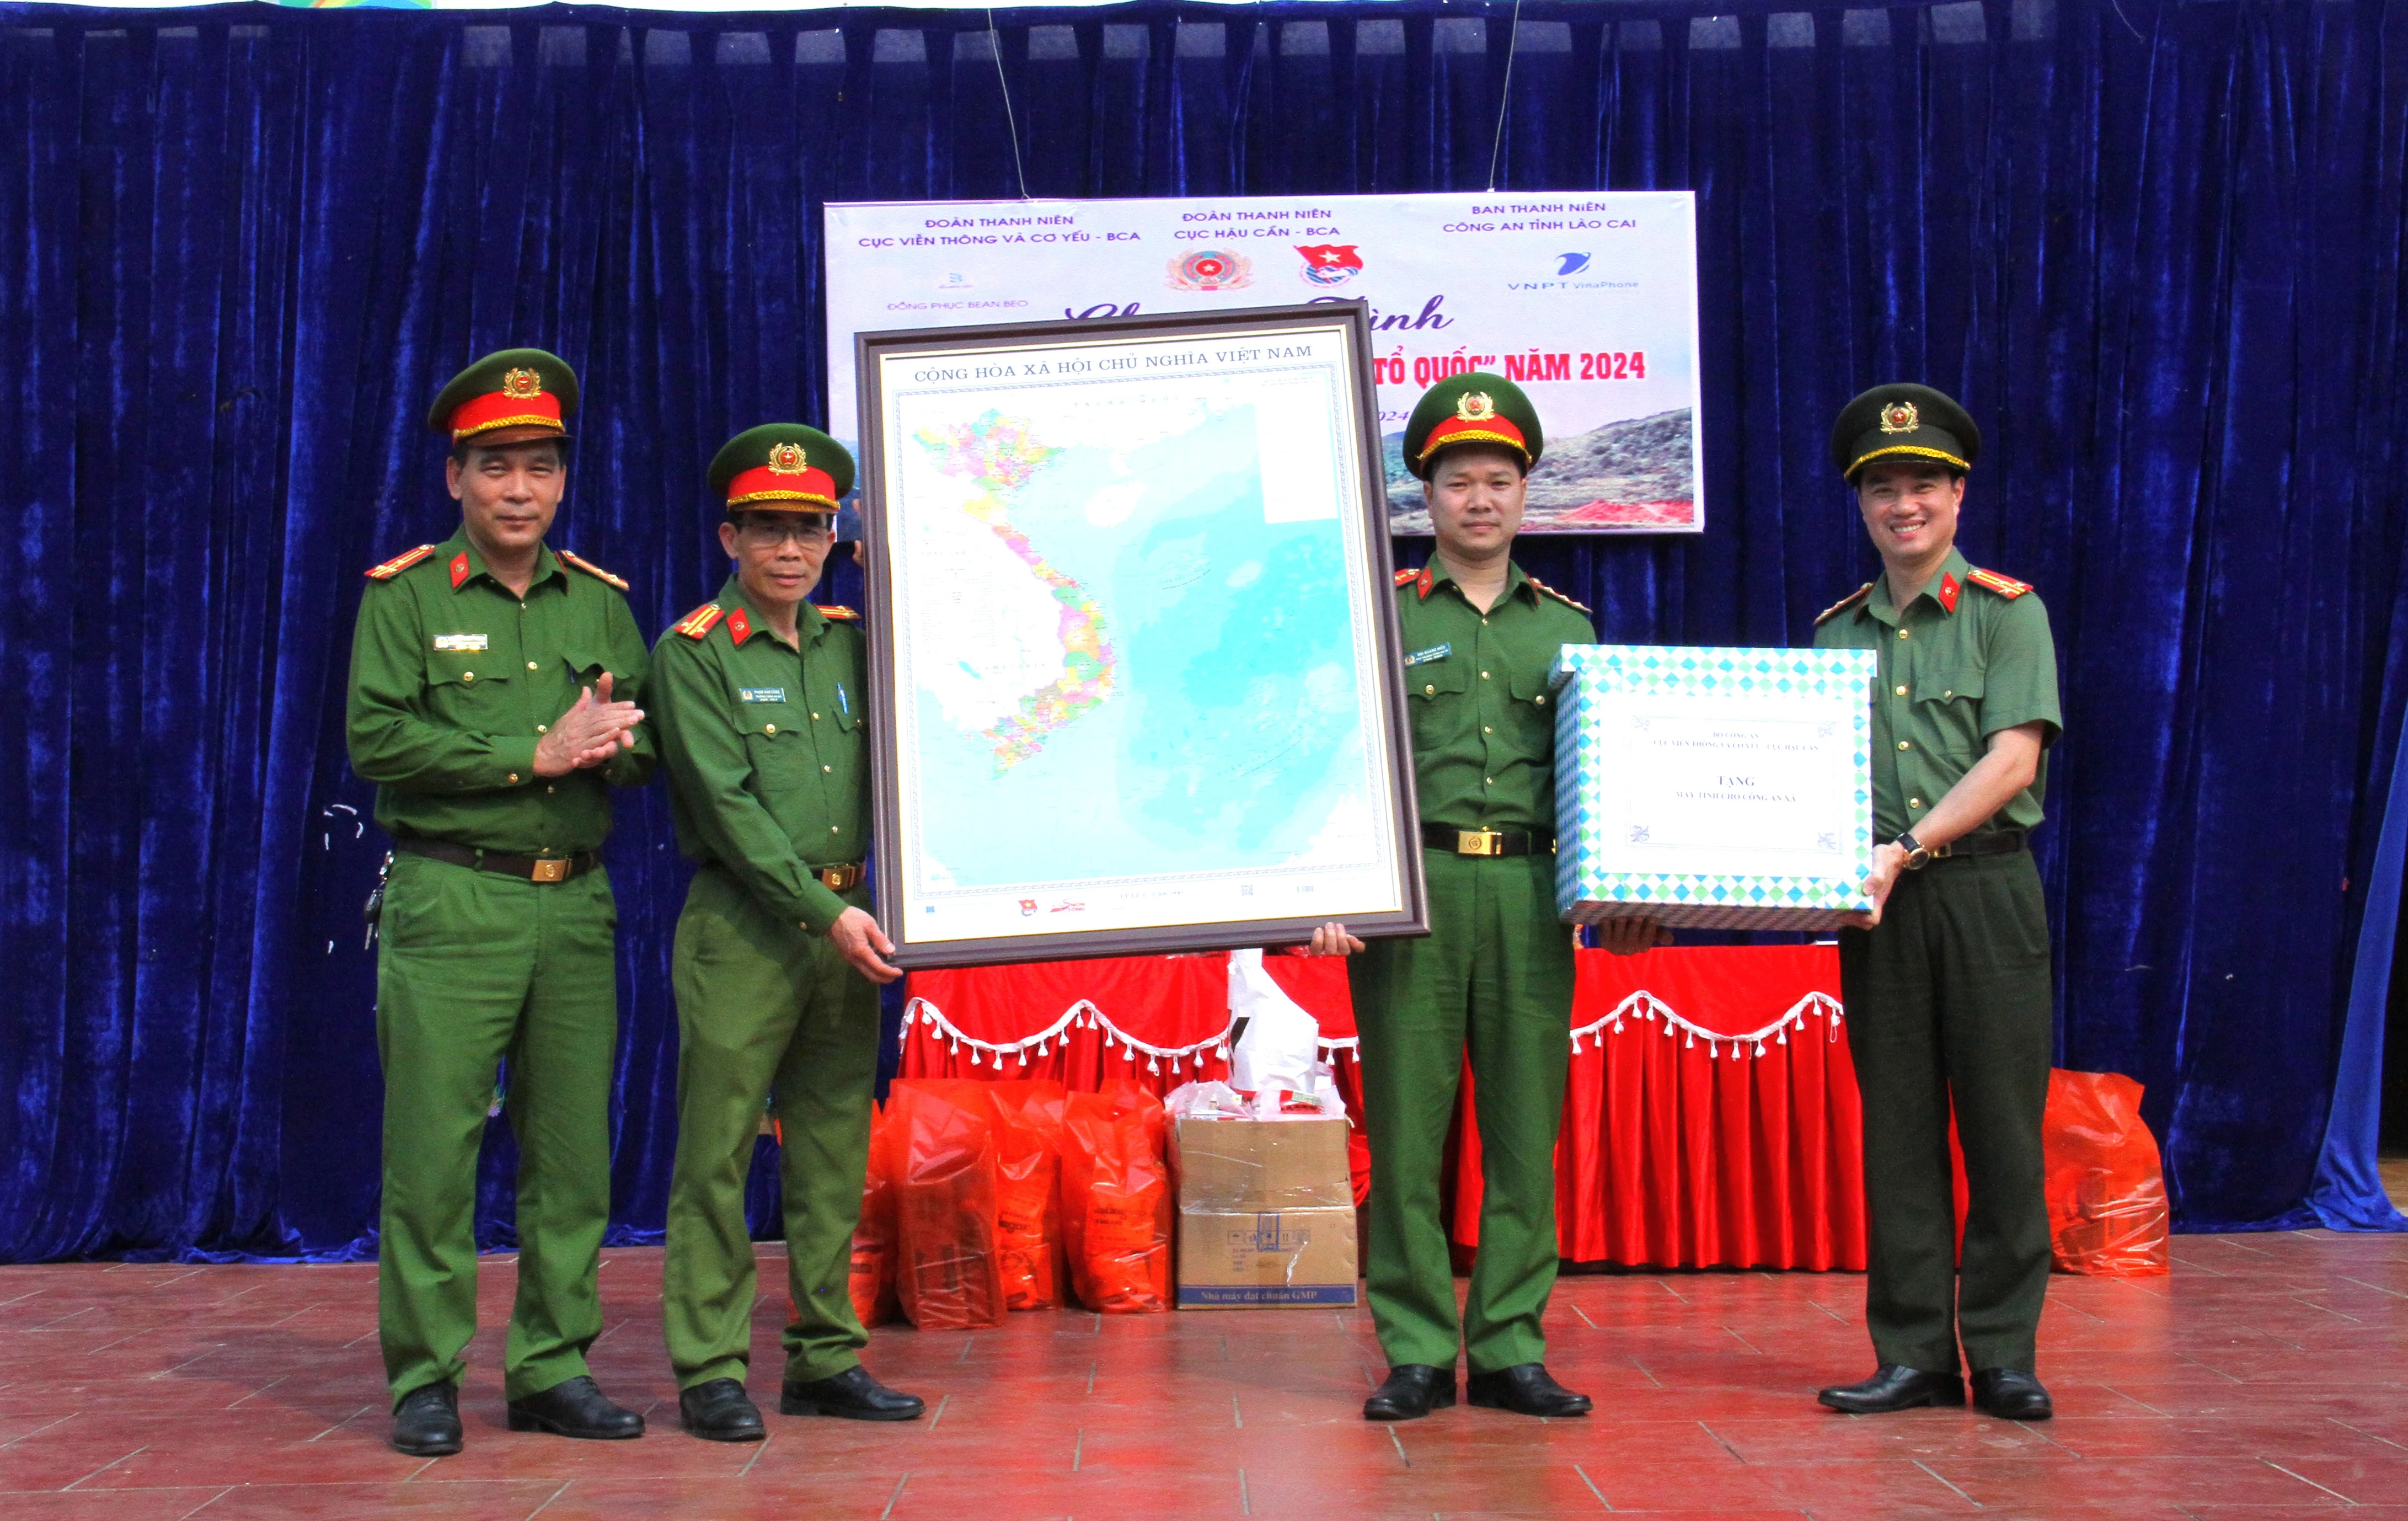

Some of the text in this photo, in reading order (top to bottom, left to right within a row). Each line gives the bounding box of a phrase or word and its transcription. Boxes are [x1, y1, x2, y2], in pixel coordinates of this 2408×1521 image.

[1182, 208, 1331, 221] ĐOÀN THANH NIÊN
[1472, 206, 1504, 214] BAN
[1510, 204, 1563, 213] THANH
[925, 215, 1074, 227] ĐOÀN THANH NIÊN
[1443, 222, 1495, 232] CÔNG
[1500, 222, 1523, 231] AN
[1569, 218, 1602, 229] LÀO
[1607, 220, 1636, 228] CAI
[859, 238, 894, 248] CỤC
[940, 234, 997, 244] THÔNG
[1003, 232, 1025, 243] VÀ
[1030, 233, 1057, 243] CƠ
[1062, 230, 1090, 242] YẾU
[1107, 232, 1141, 241] BCA
[1174, 230, 1210, 241] CỤC
[1215, 228, 1248, 239] HẬU
[1306, 227, 1340, 236] BCA
[1508, 282, 1567, 290] VNPT
[975, 363, 1016, 378] HÒA
[1023, 361, 1051, 375] XÃ
[1099, 353, 1137, 371] CHỦ
[1267, 345, 1312, 359] NAM
[1505, 349, 1571, 381] NĂM
[1580, 351, 1645, 380] 2024
[1379, 411, 1409, 420] 024
[1292, 1290, 1317, 1299] GMP
